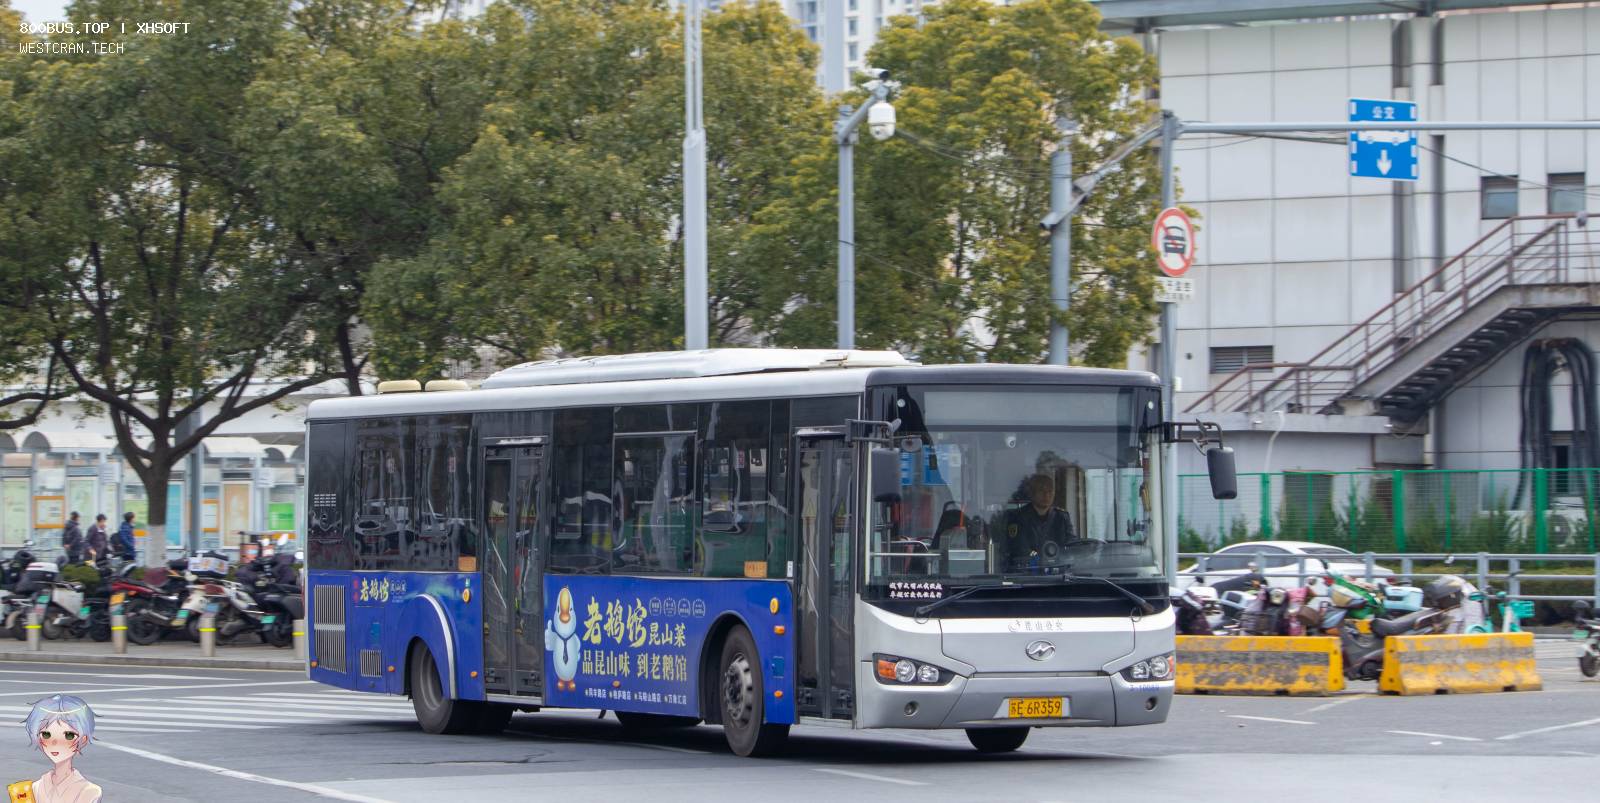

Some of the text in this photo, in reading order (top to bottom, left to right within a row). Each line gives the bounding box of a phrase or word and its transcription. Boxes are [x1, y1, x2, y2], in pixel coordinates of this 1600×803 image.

[1372, 105, 1395, 120] 公交
[648, 622, 687, 648] 昆山菜
[582, 649, 687, 682] 品昆山味 到老鹅馆
